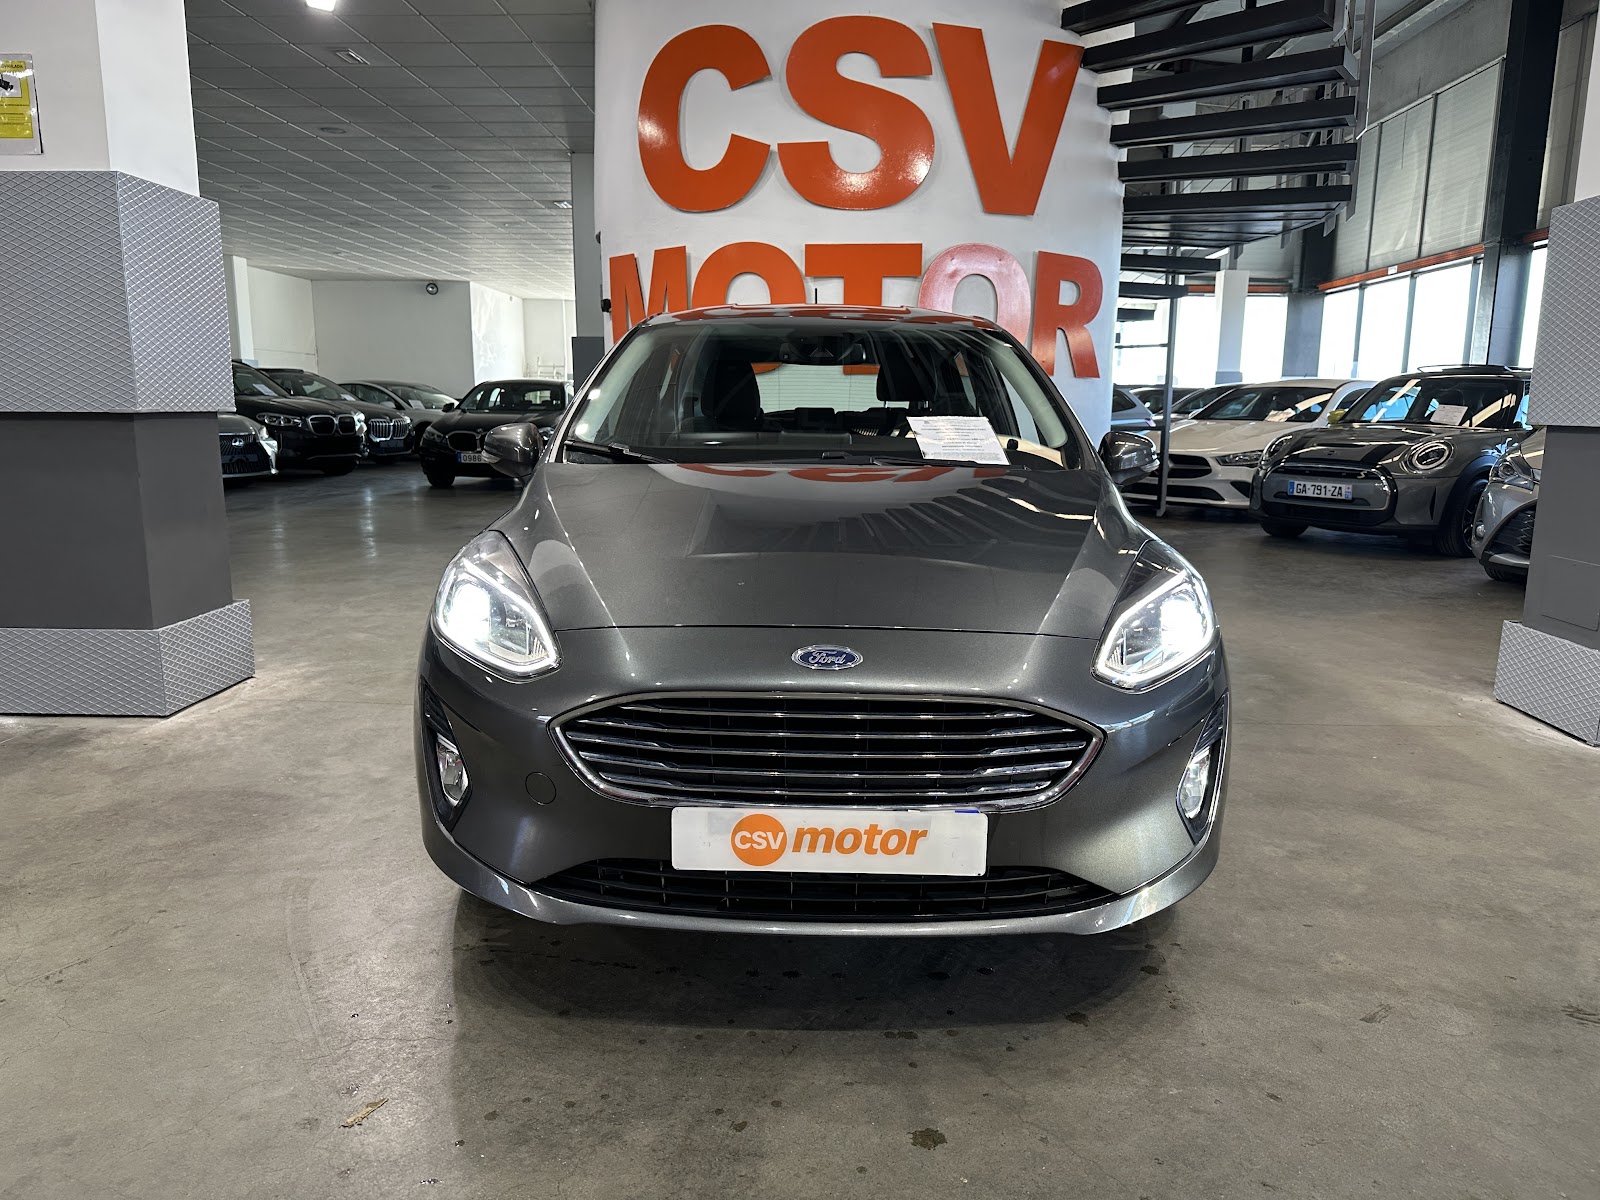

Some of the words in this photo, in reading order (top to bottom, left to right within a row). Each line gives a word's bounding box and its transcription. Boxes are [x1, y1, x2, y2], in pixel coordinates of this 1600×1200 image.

[638, 15, 1084, 216] CSV
[1296, 484, 1343, 497] GA-791-ZA
[808, 650, 847, 664] Ford
[734, 830, 785, 850] CSV
[792, 823, 928, 856] motor
